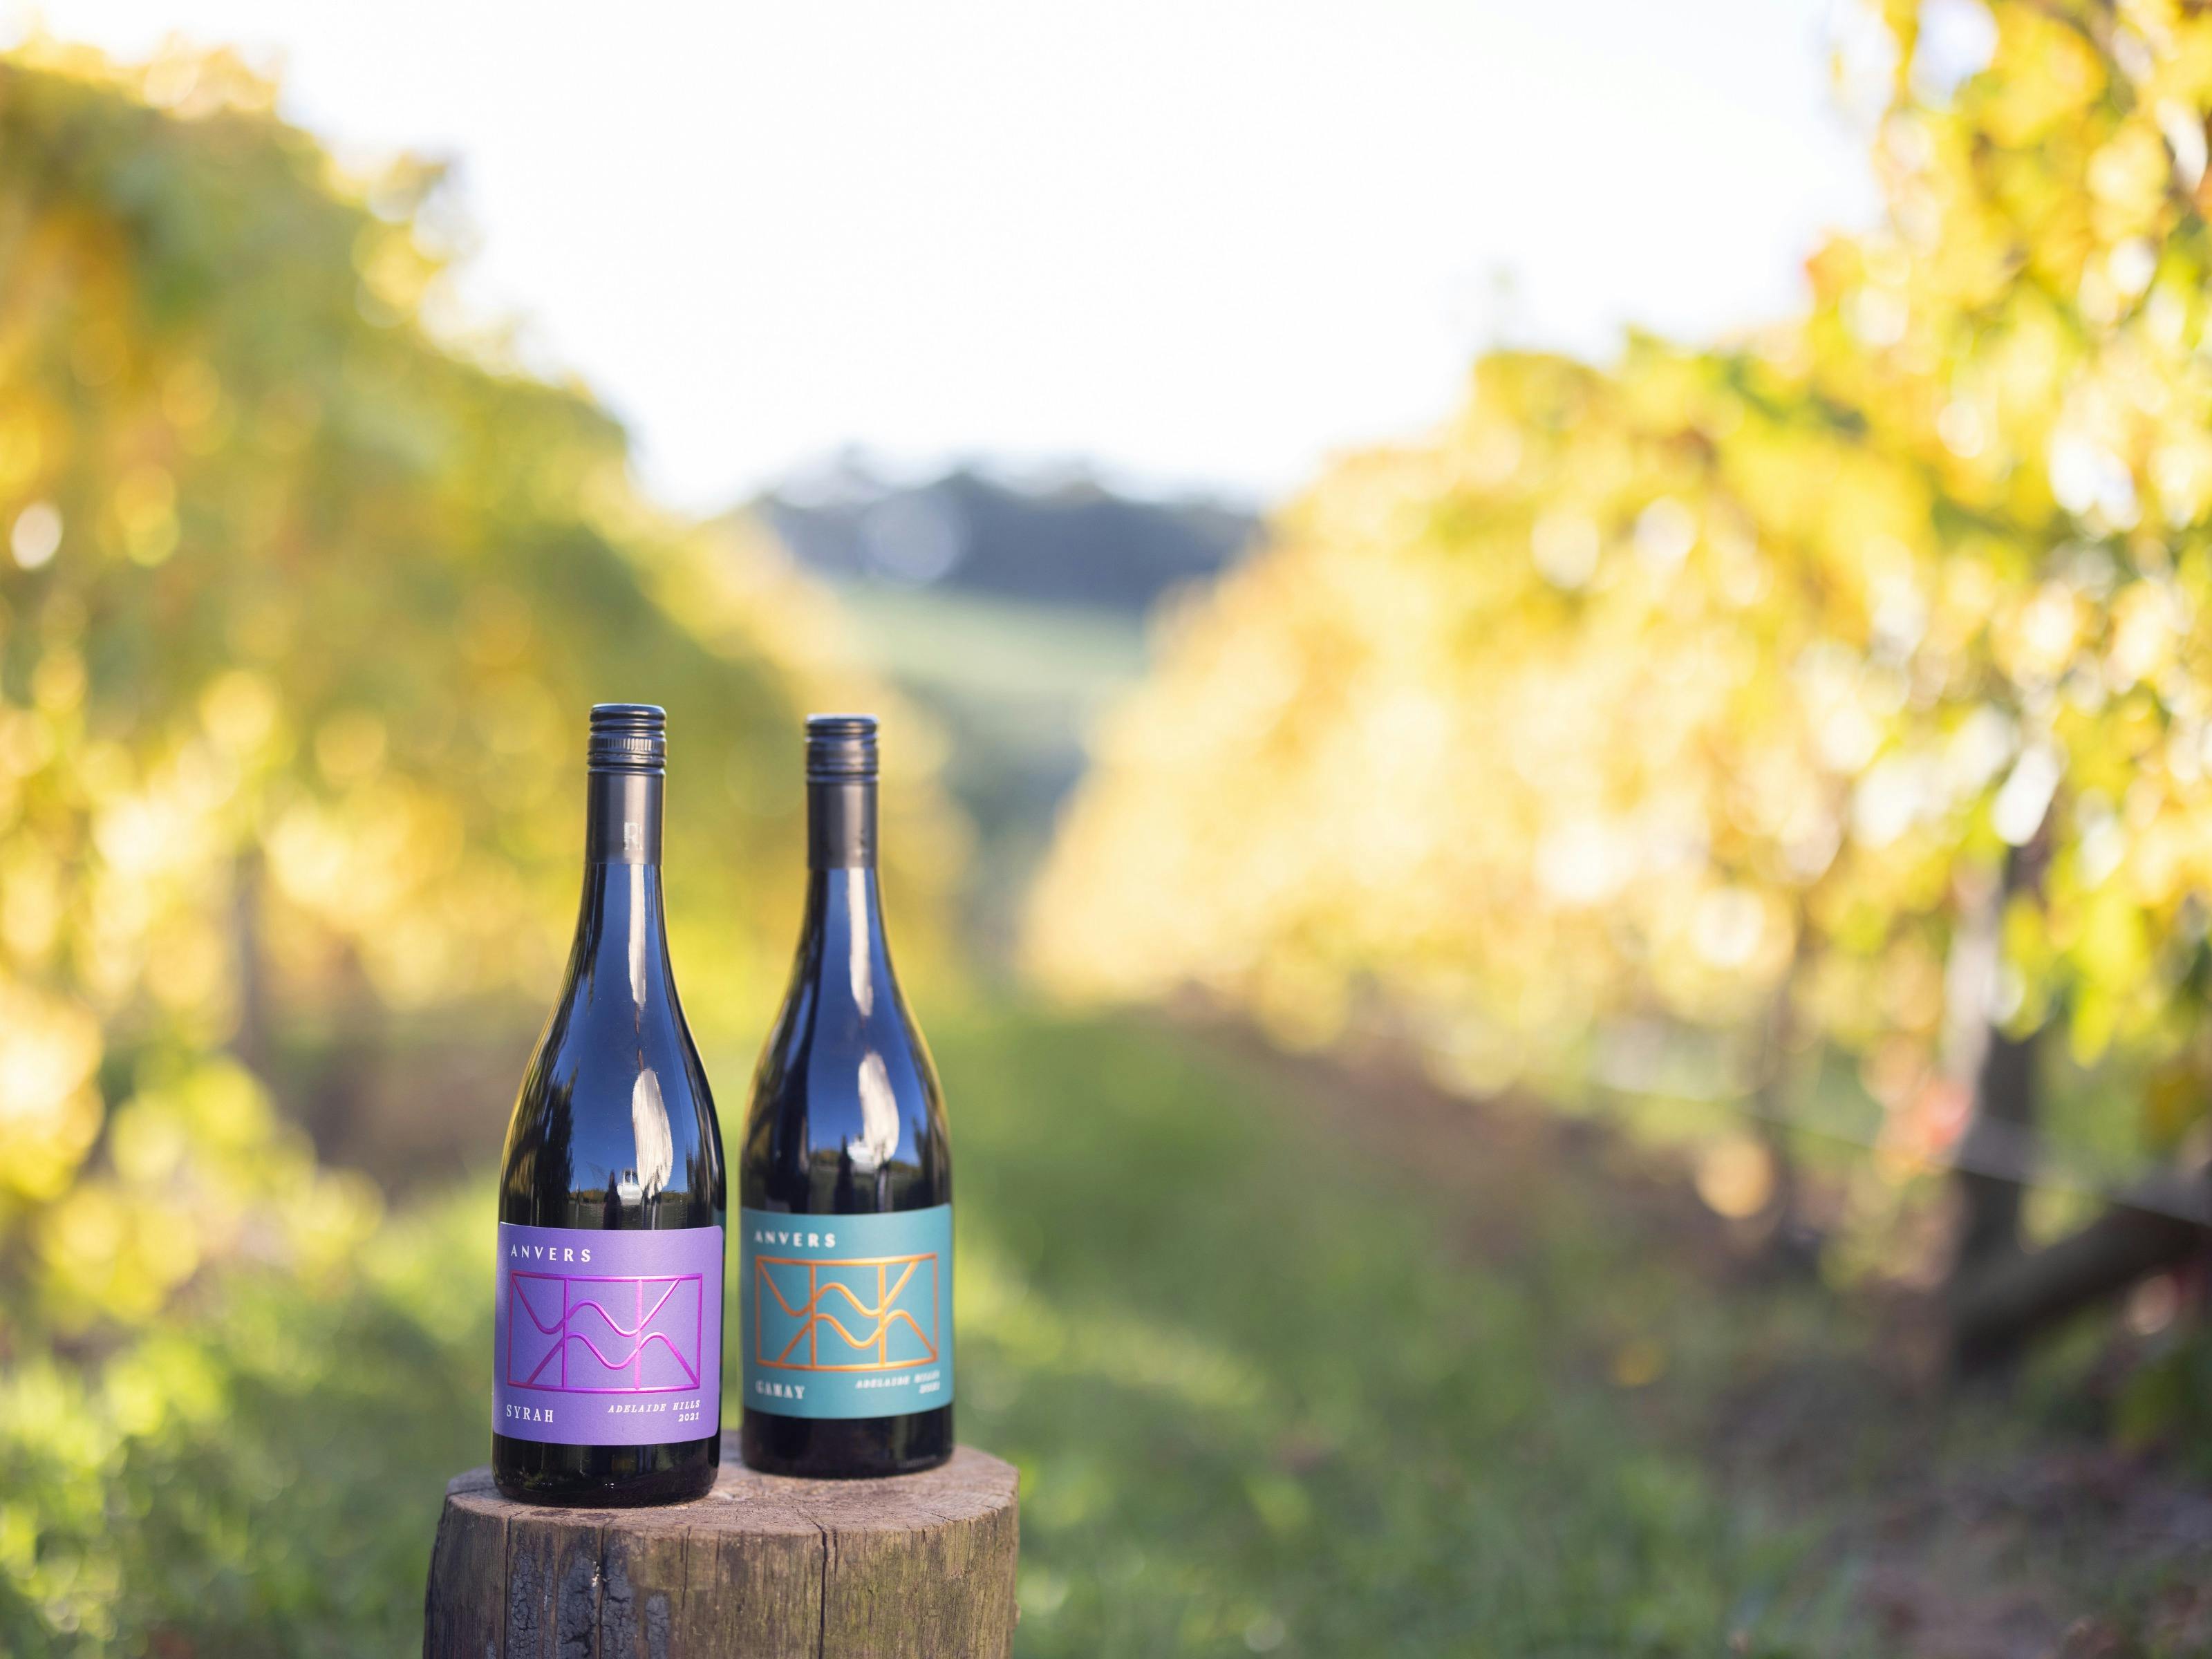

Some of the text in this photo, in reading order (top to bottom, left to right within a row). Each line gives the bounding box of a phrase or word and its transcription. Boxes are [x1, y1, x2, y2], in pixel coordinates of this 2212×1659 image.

[754, 1230, 836, 1248] ANVERS
[511, 1244, 591, 1262] ANVERS
[756, 1380, 805, 1400] GAMAY
[507, 1404, 554, 1423] SYRAH
[608, 1399, 700, 1413] ADELAIDE HILLS
[678, 1412, 700, 1422] 2021
